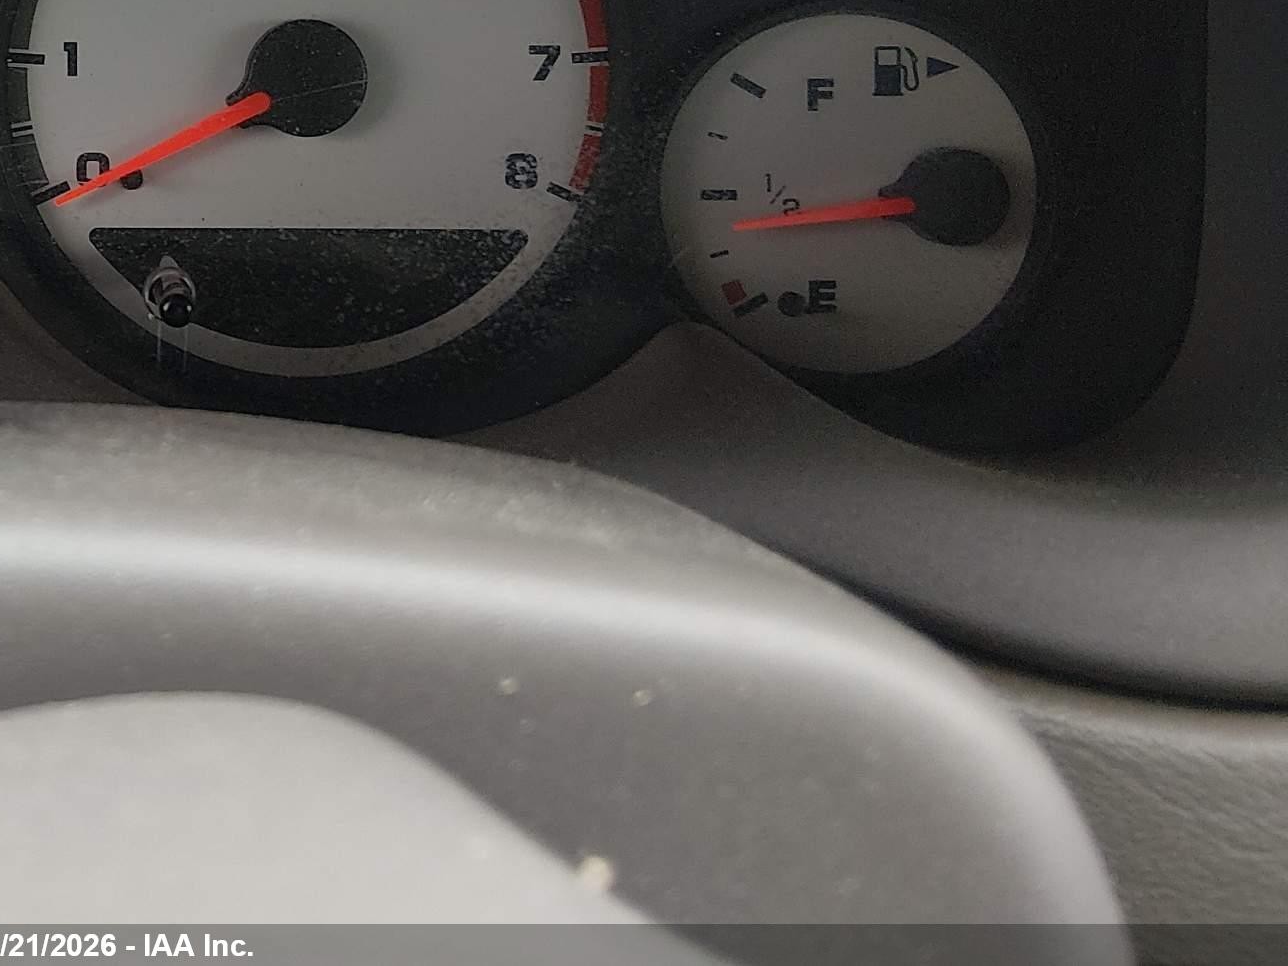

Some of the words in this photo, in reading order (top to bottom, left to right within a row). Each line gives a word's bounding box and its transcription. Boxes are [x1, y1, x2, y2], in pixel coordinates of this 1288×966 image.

[63, 41, 78, 77] 1
[528, 45, 561, 81] 7
[806, 78, 834, 111] F
[504, 152, 538, 191] 8
[808, 279, 837, 315] E
